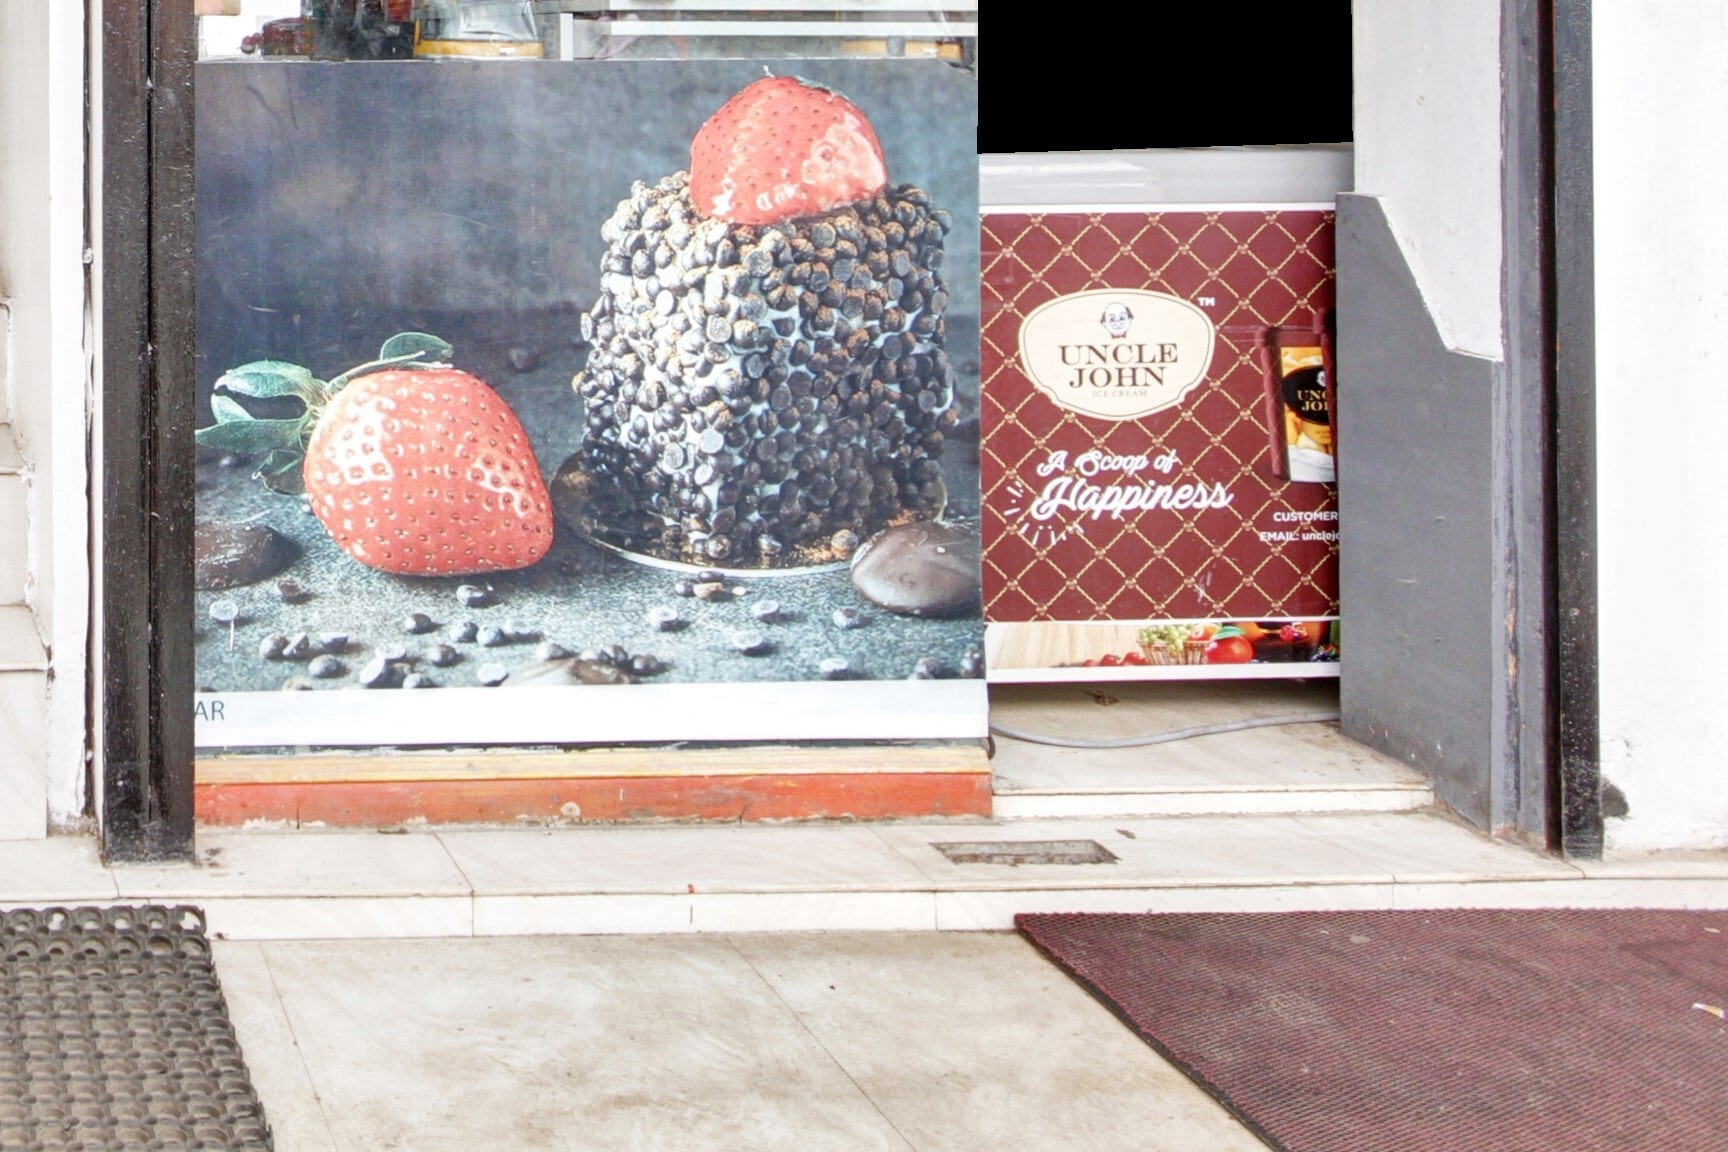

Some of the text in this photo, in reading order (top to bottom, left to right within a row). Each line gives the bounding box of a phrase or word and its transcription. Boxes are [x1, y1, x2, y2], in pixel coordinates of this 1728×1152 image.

[1058, 342, 1178, 366] UNCLE
[1069, 366, 1165, 389] JOHN
[1111, 389, 1148, 398] CREAM
[1036, 448, 1180, 477] A Scoop of
[1030, 476, 1235, 522] Happiness
[1273, 511, 1339, 522] CUSTOMER
[1259, 531, 1300, 542] EMAIL:
